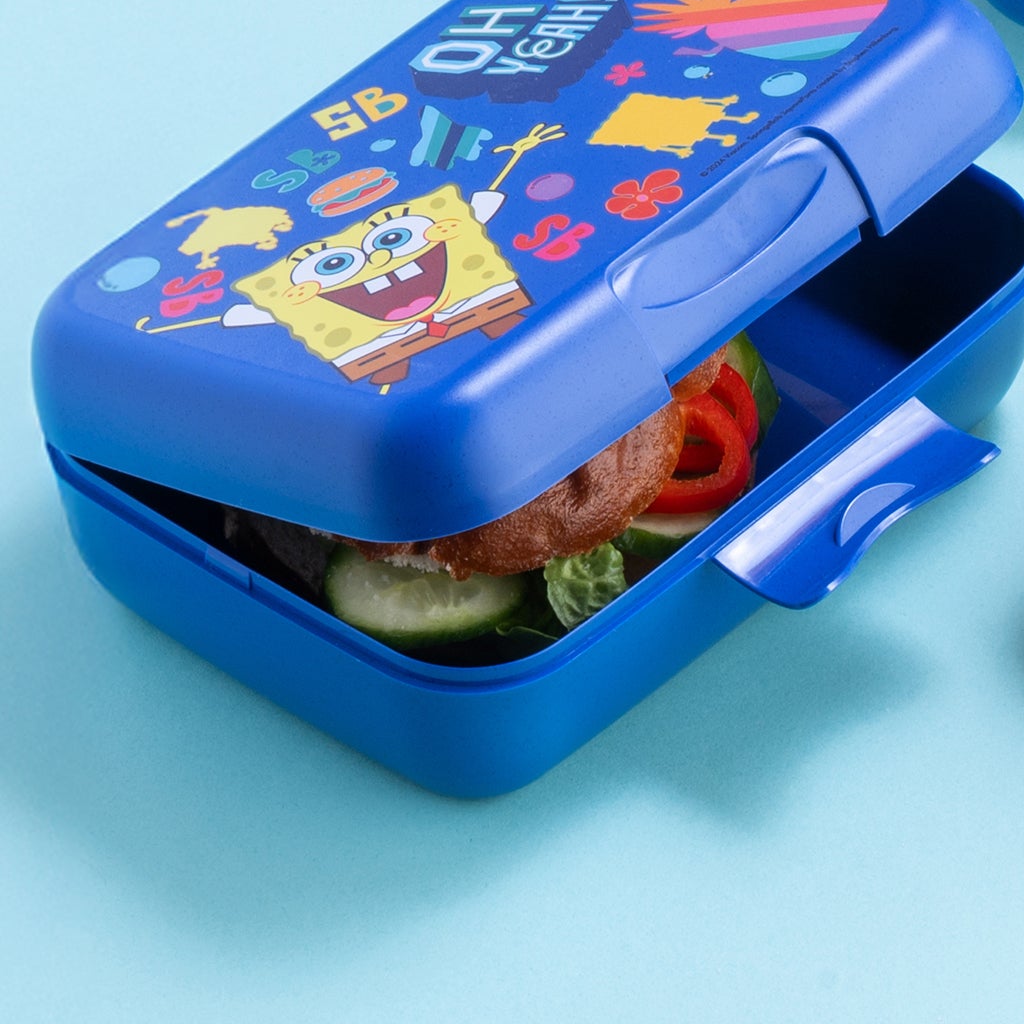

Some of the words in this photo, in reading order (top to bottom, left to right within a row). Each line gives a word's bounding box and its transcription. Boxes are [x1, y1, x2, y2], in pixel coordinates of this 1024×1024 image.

[408, 3, 547, 75] OH
[310, 86, 408, 141] SB
[251, 148, 342, 194] SB
[513, 214, 595, 261] SB
[160, 269, 225, 318] SB
